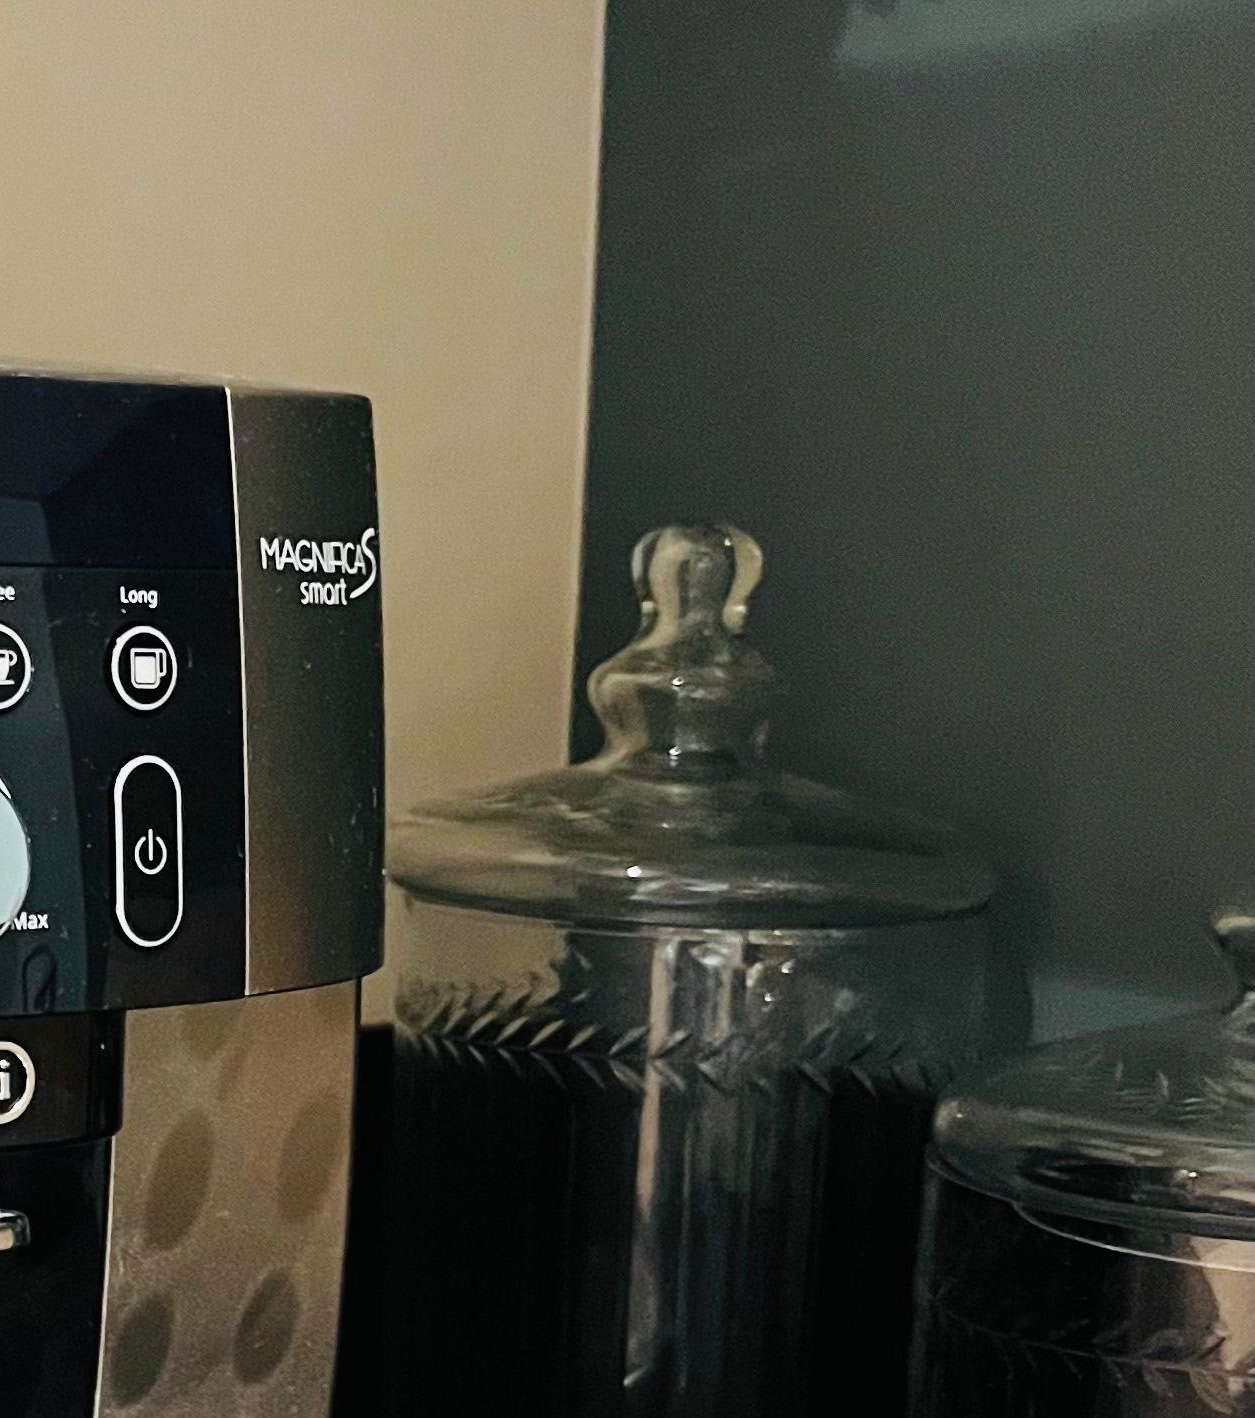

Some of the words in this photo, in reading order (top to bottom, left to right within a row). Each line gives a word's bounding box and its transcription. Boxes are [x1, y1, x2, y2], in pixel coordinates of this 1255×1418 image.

[119, 585, 158, 608] Long
[299, 577, 348, 606] smart
[10, 911, 49, 930] Max
